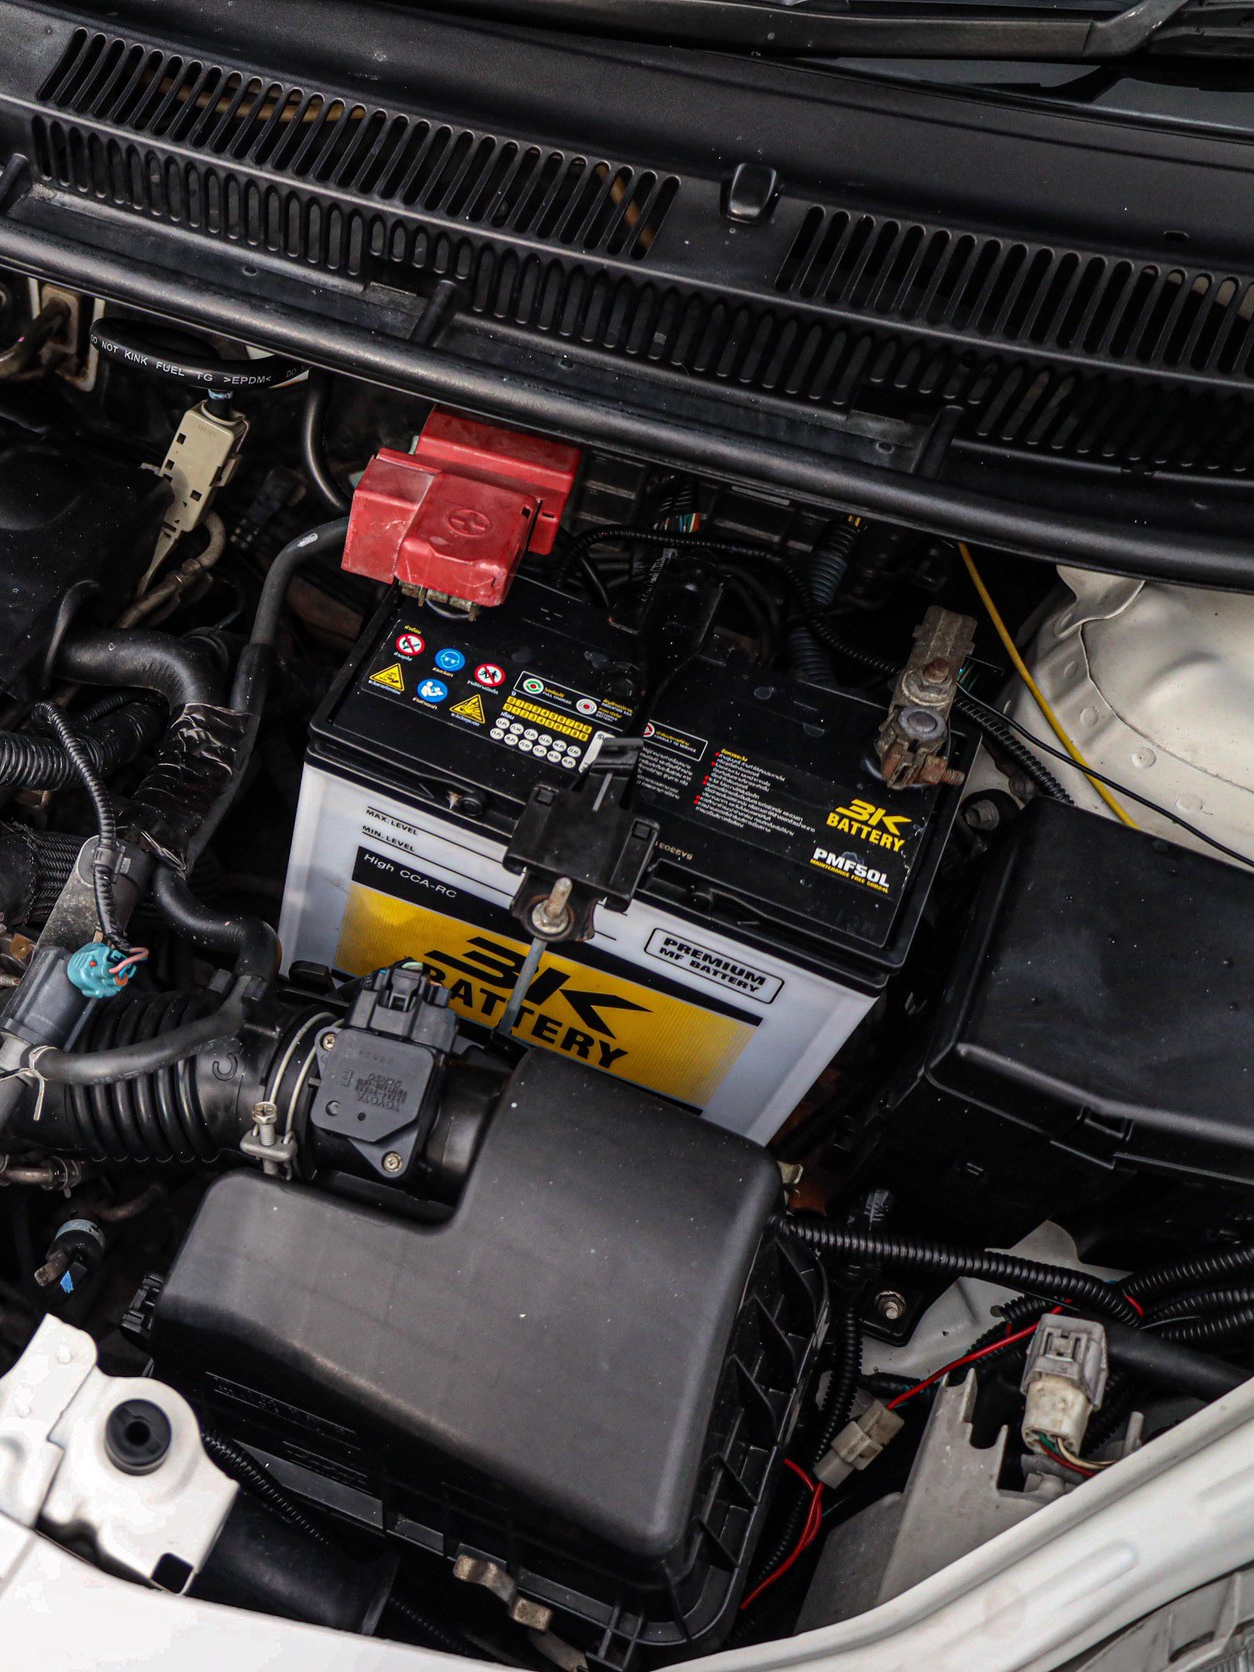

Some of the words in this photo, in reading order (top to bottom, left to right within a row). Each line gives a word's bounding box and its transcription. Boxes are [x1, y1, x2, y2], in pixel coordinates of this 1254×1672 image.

[101, 340, 119, 354] NOT
[124, 350, 148, 366] KINK
[156, 361, 185, 377] FUEL
[196, 372, 213, 383] TG
[366, 809, 389, 824] MAX.
[391, 820, 418, 836] LEVEL
[826, 812, 905, 852] BATTERY
[835, 799, 912, 836] 3K
[362, 825, 384, 839] MIN.
[386, 836, 415, 852] LEVEL
[364, 853, 395, 872] High
[399, 869, 458, 898] CCA-RC
[809, 858, 850, 878] MAINTENANCE
[851, 874, 866, 884] FREE
[812, 847, 890, 888] PMF50L
[659, 947, 685, 961] MF
[689, 960, 760, 993] BATTERY
[663, 937, 767, 986] PREMIUM
[424, 936, 653, 1040] 3K
[357, 1093, 399, 1112] TOYOTA
